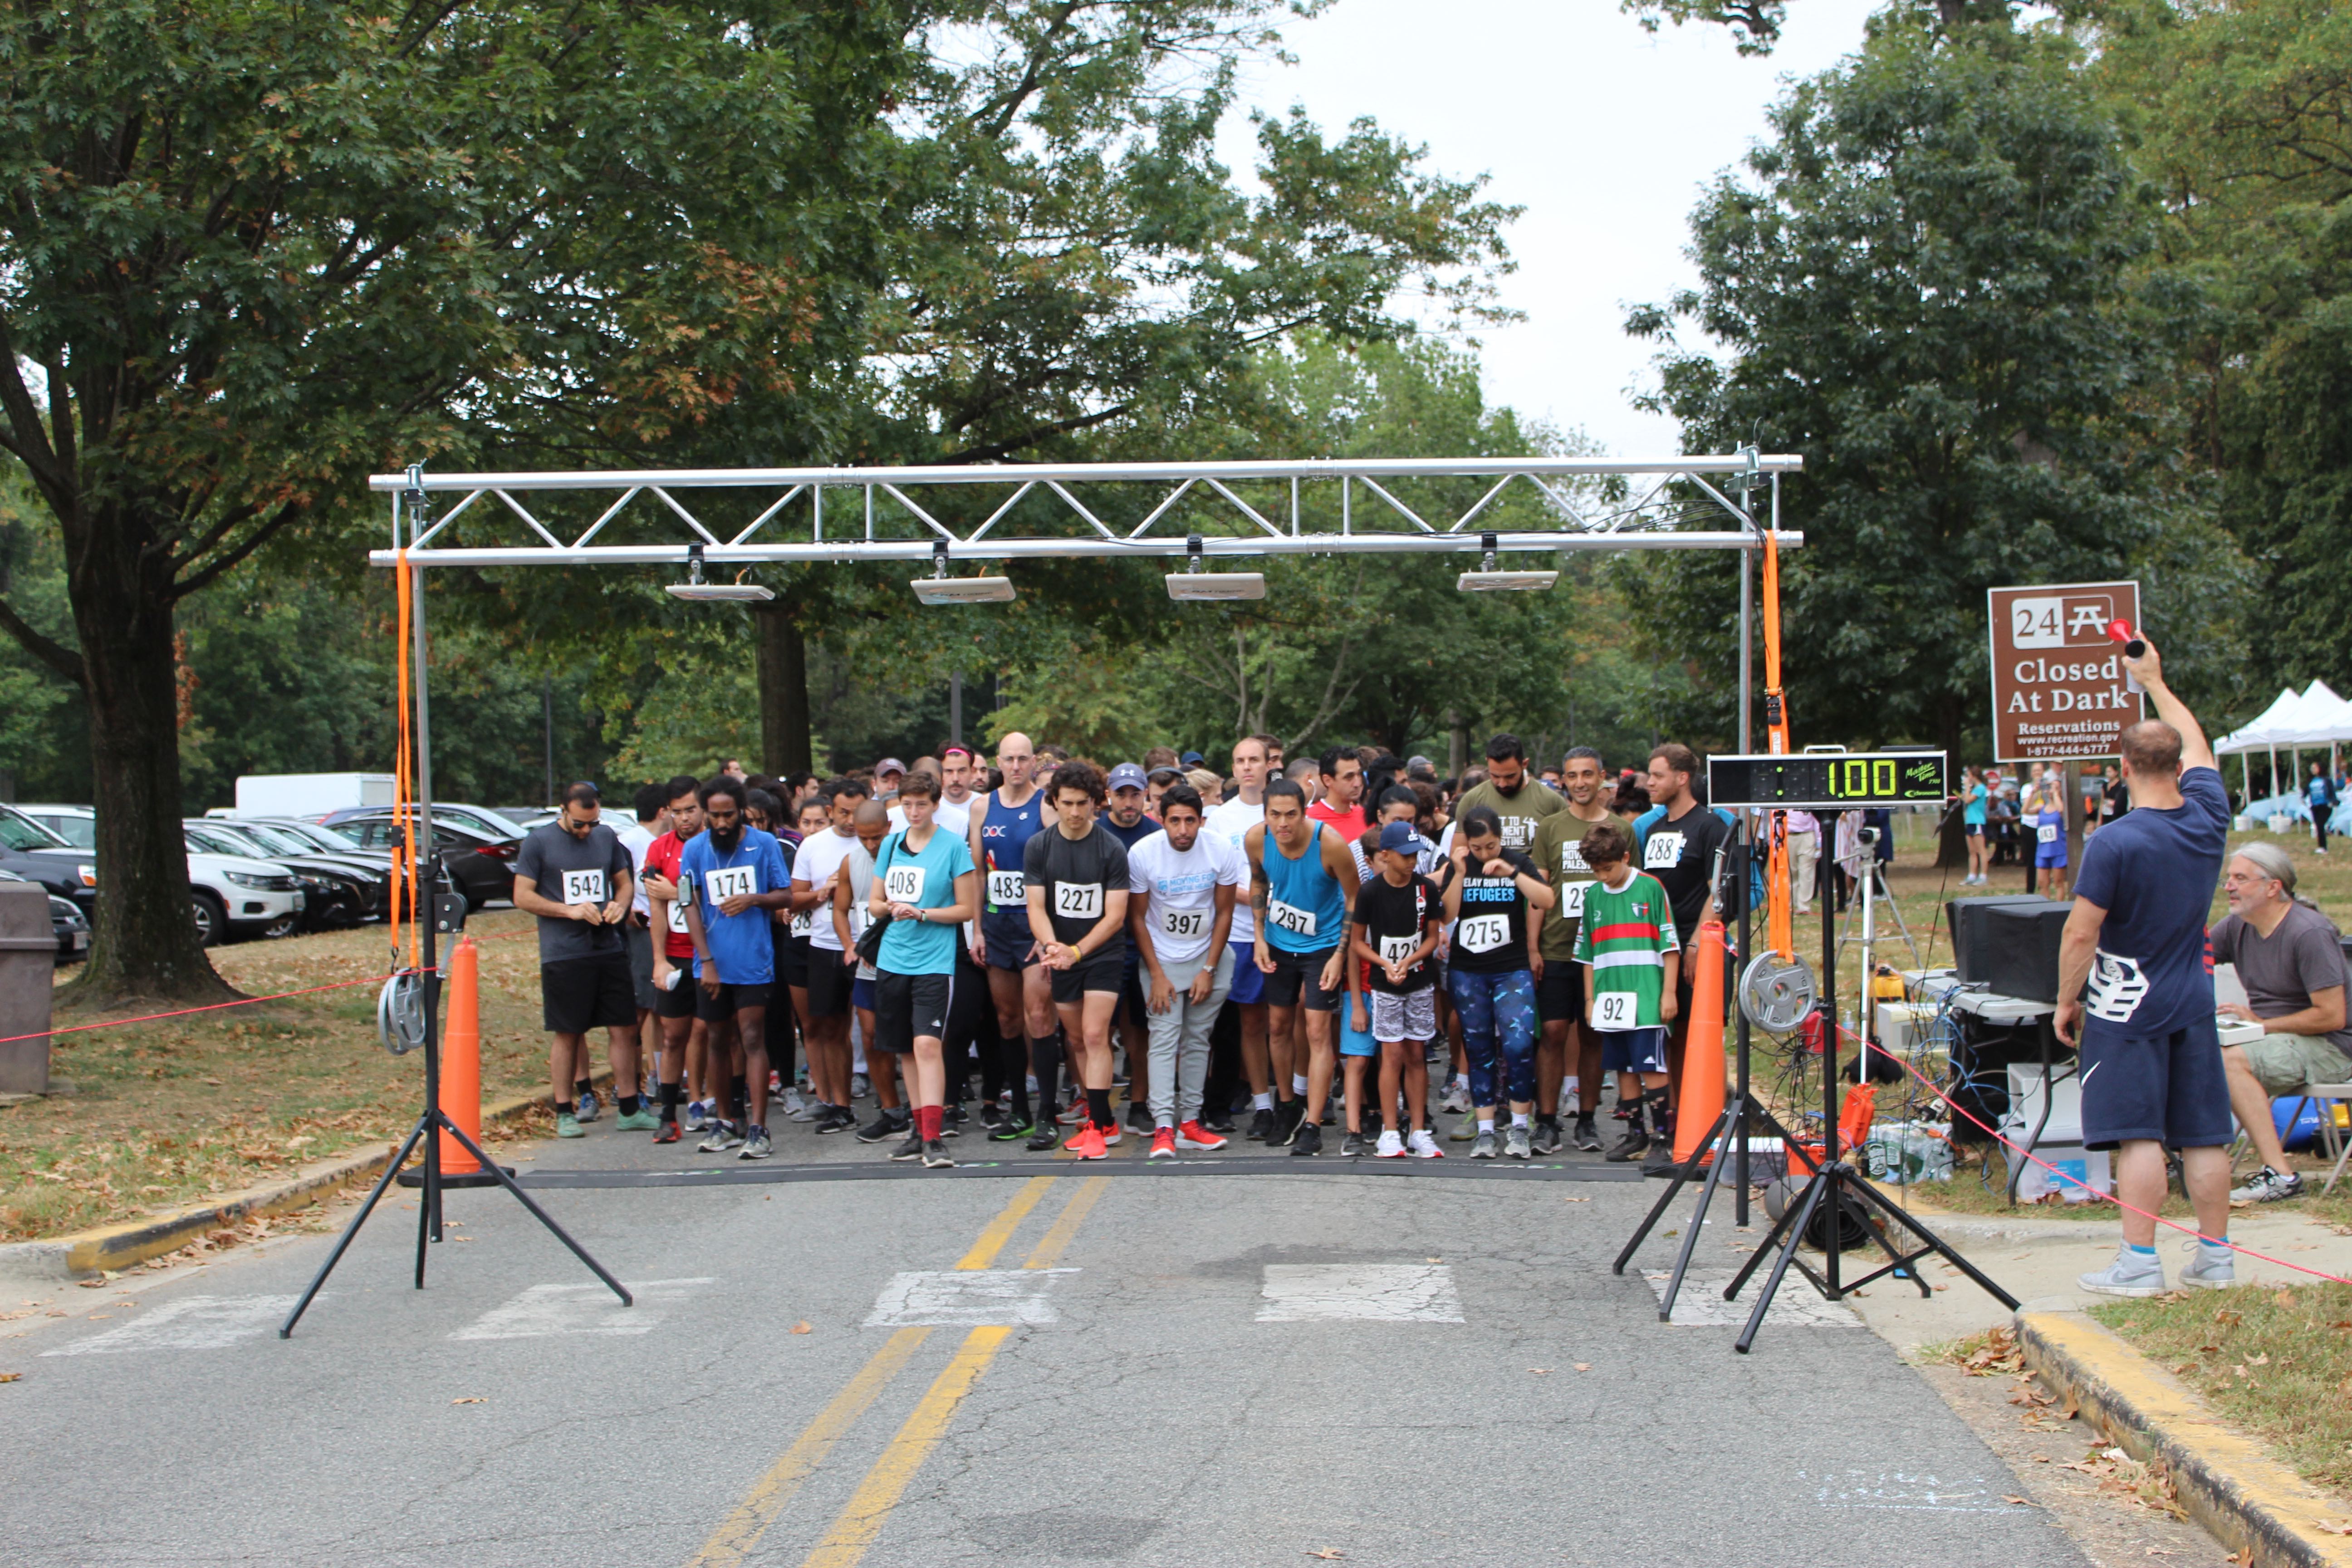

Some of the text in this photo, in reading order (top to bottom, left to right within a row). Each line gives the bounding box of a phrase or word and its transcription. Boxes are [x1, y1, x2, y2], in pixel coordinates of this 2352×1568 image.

[2016, 607, 2059, 638] 24
[2014, 654, 2120, 684] Closed
[2007, 684, 2130, 714] At Dark
[2018, 719, 2121, 735] Reservations
[2017, 733, 2120, 745] www.recreation.gov
[2026, 744, 2111, 757] 1-877-444-6777
[1905, 762, 1933, 779] Master
[1918, 770, 1936, 782] Time
[1500, 826, 1526, 836] MENT
[1508, 816, 1519, 826] TO
[1500, 836, 1525, 846] STINE
[1647, 838, 1674, 861] 288
[570, 871, 600, 897] 542
[715, 872, 749, 898] 174
[887, 872, 916, 895] 408
[994, 877, 1024, 899] 483
[1169, 875, 1200, 886] MOVING
[1463, 877, 1483, 887] ELAY
[1483, 877, 1500, 887] RUN
[1061, 888, 1094, 912] 227
[1166, 913, 1202, 935] 397
[1276, 906, 1308, 933] 297
[1466, 921, 1502, 947] 275
[1603, 997, 1623, 1021] 92
